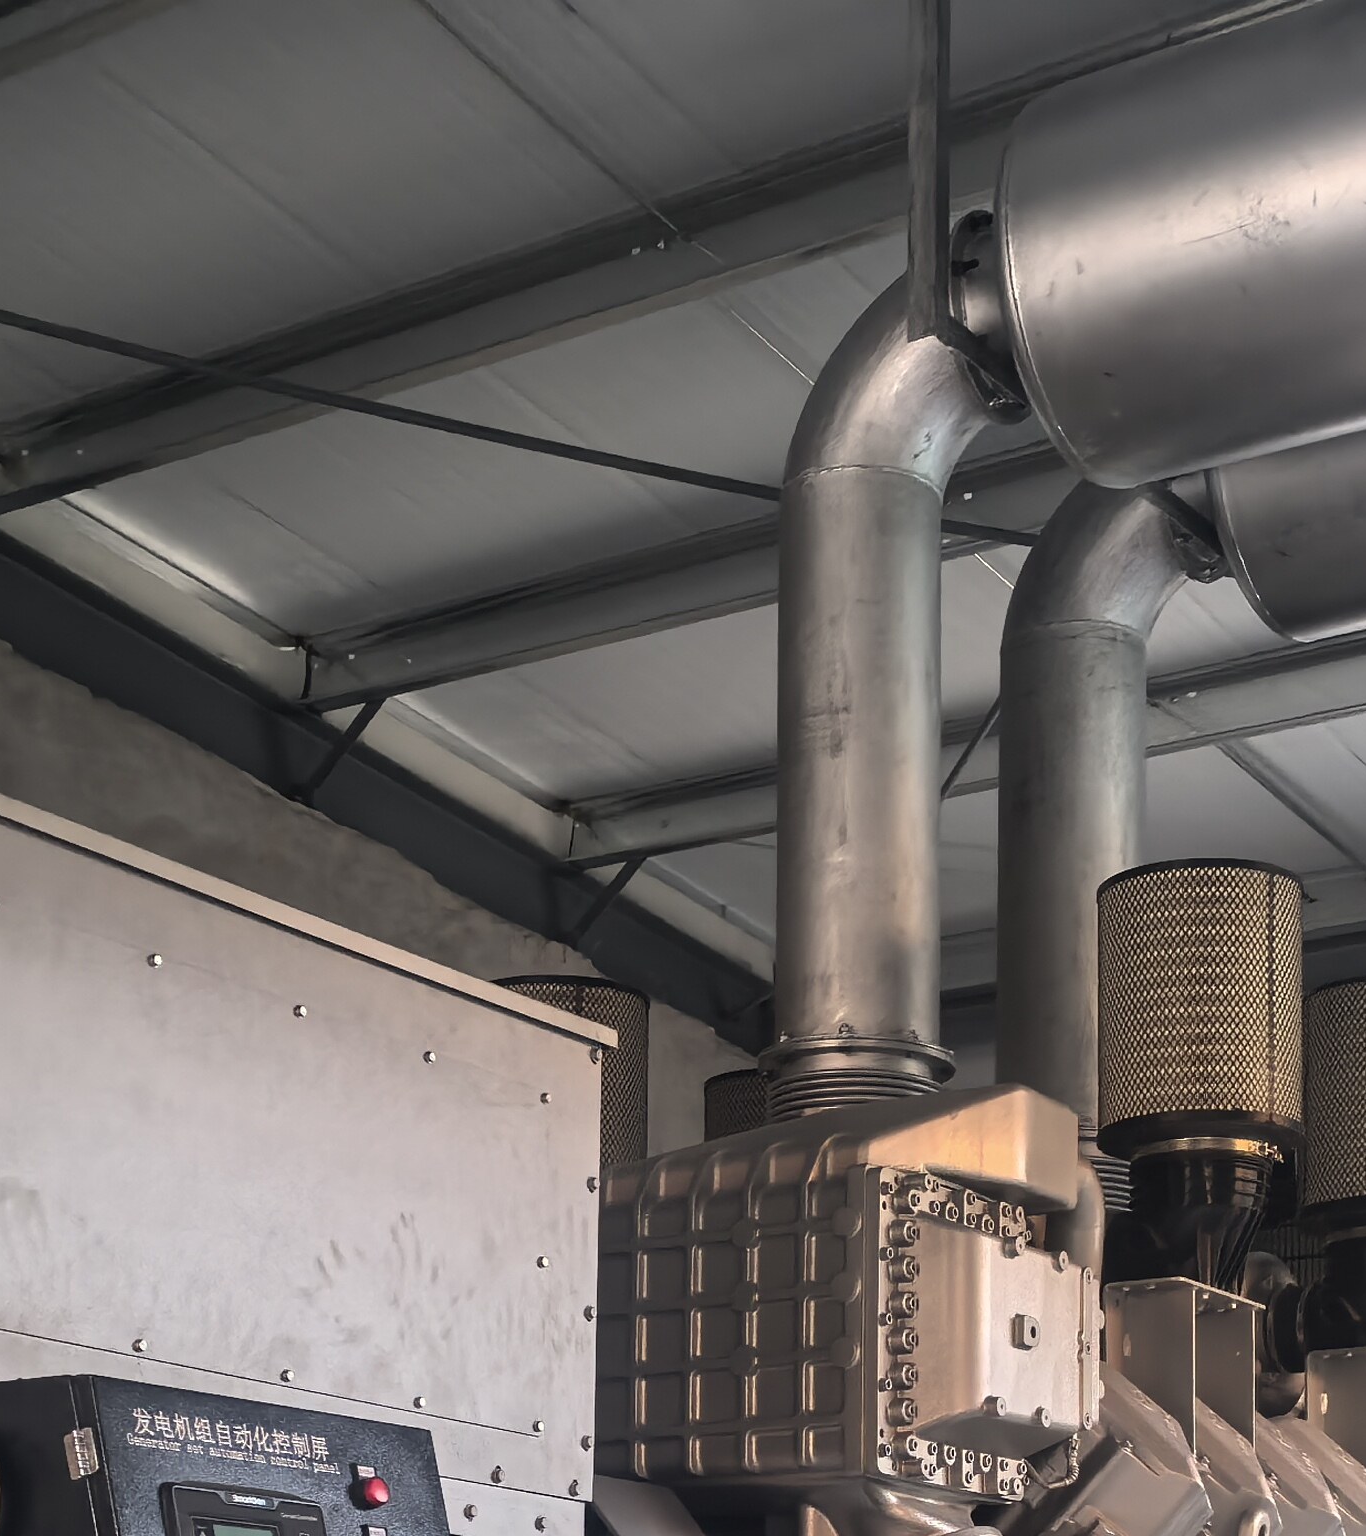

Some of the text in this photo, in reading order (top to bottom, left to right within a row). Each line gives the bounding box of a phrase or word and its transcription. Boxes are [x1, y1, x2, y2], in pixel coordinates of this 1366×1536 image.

[126, 1432, 182, 1452] Generator
[313, 1462, 341, 1475] panel
[131, 1407, 330, 1462] 发电机组自动化控制屏
